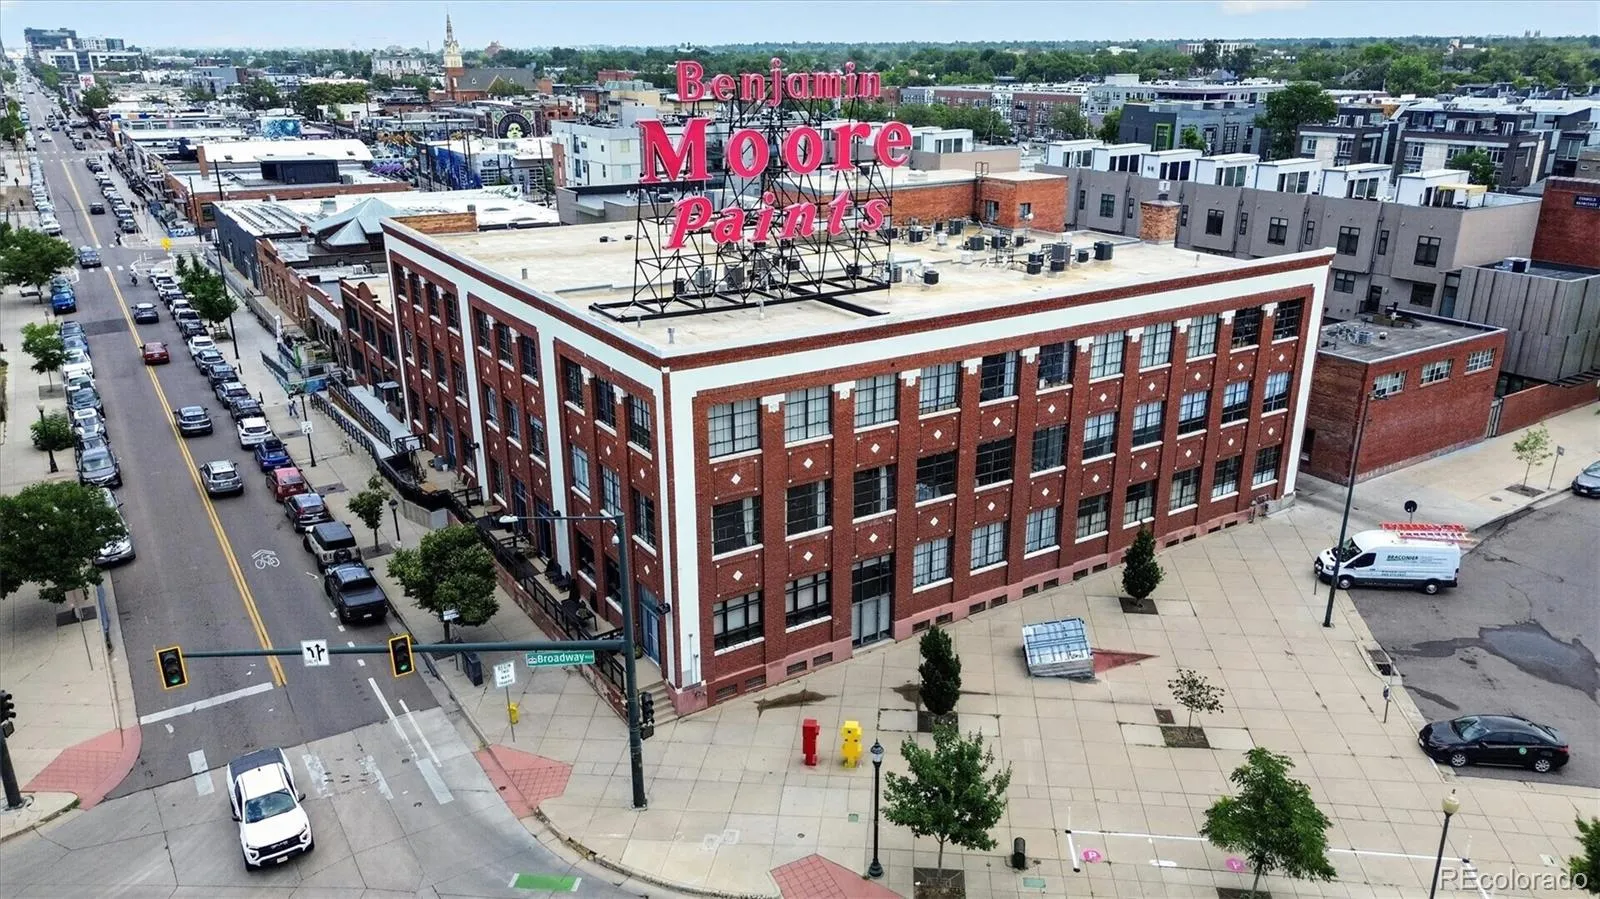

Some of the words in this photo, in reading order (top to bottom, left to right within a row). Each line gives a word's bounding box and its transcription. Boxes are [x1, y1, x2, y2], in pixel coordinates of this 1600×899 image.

[676, 57, 881, 108] Benjamin
[636, 117, 913, 184] Moore
[662, 188, 890, 250] Paints
[537, 653, 585, 664] Broadway
